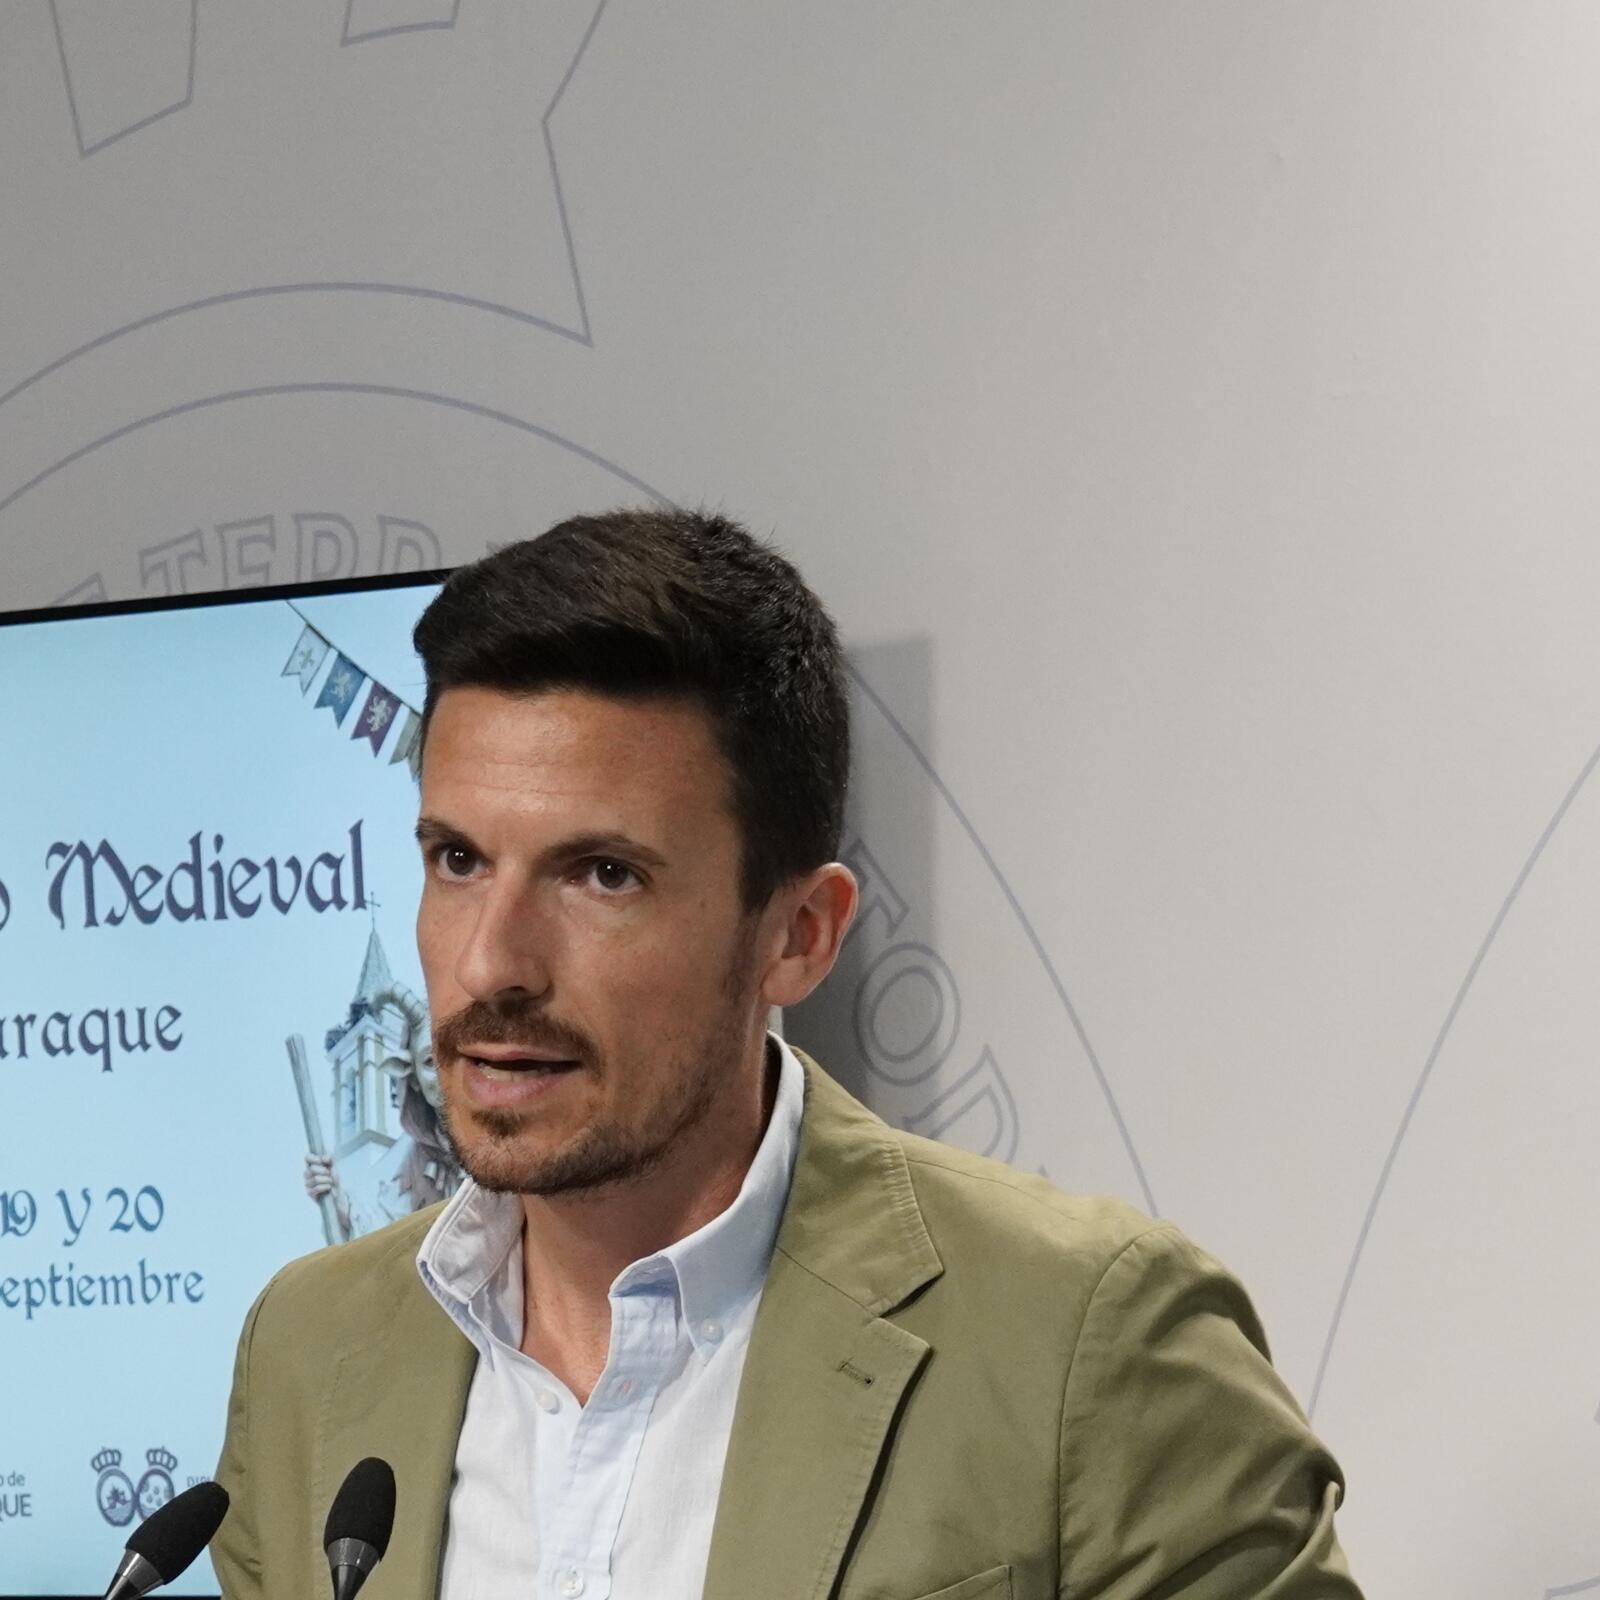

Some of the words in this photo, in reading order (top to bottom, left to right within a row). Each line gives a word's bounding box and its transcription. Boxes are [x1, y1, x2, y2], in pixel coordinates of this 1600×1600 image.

[45, 819, 368, 930] Medieval
[105, 1185, 165, 1233] 20
[7, 1470, 25, 1487] de
